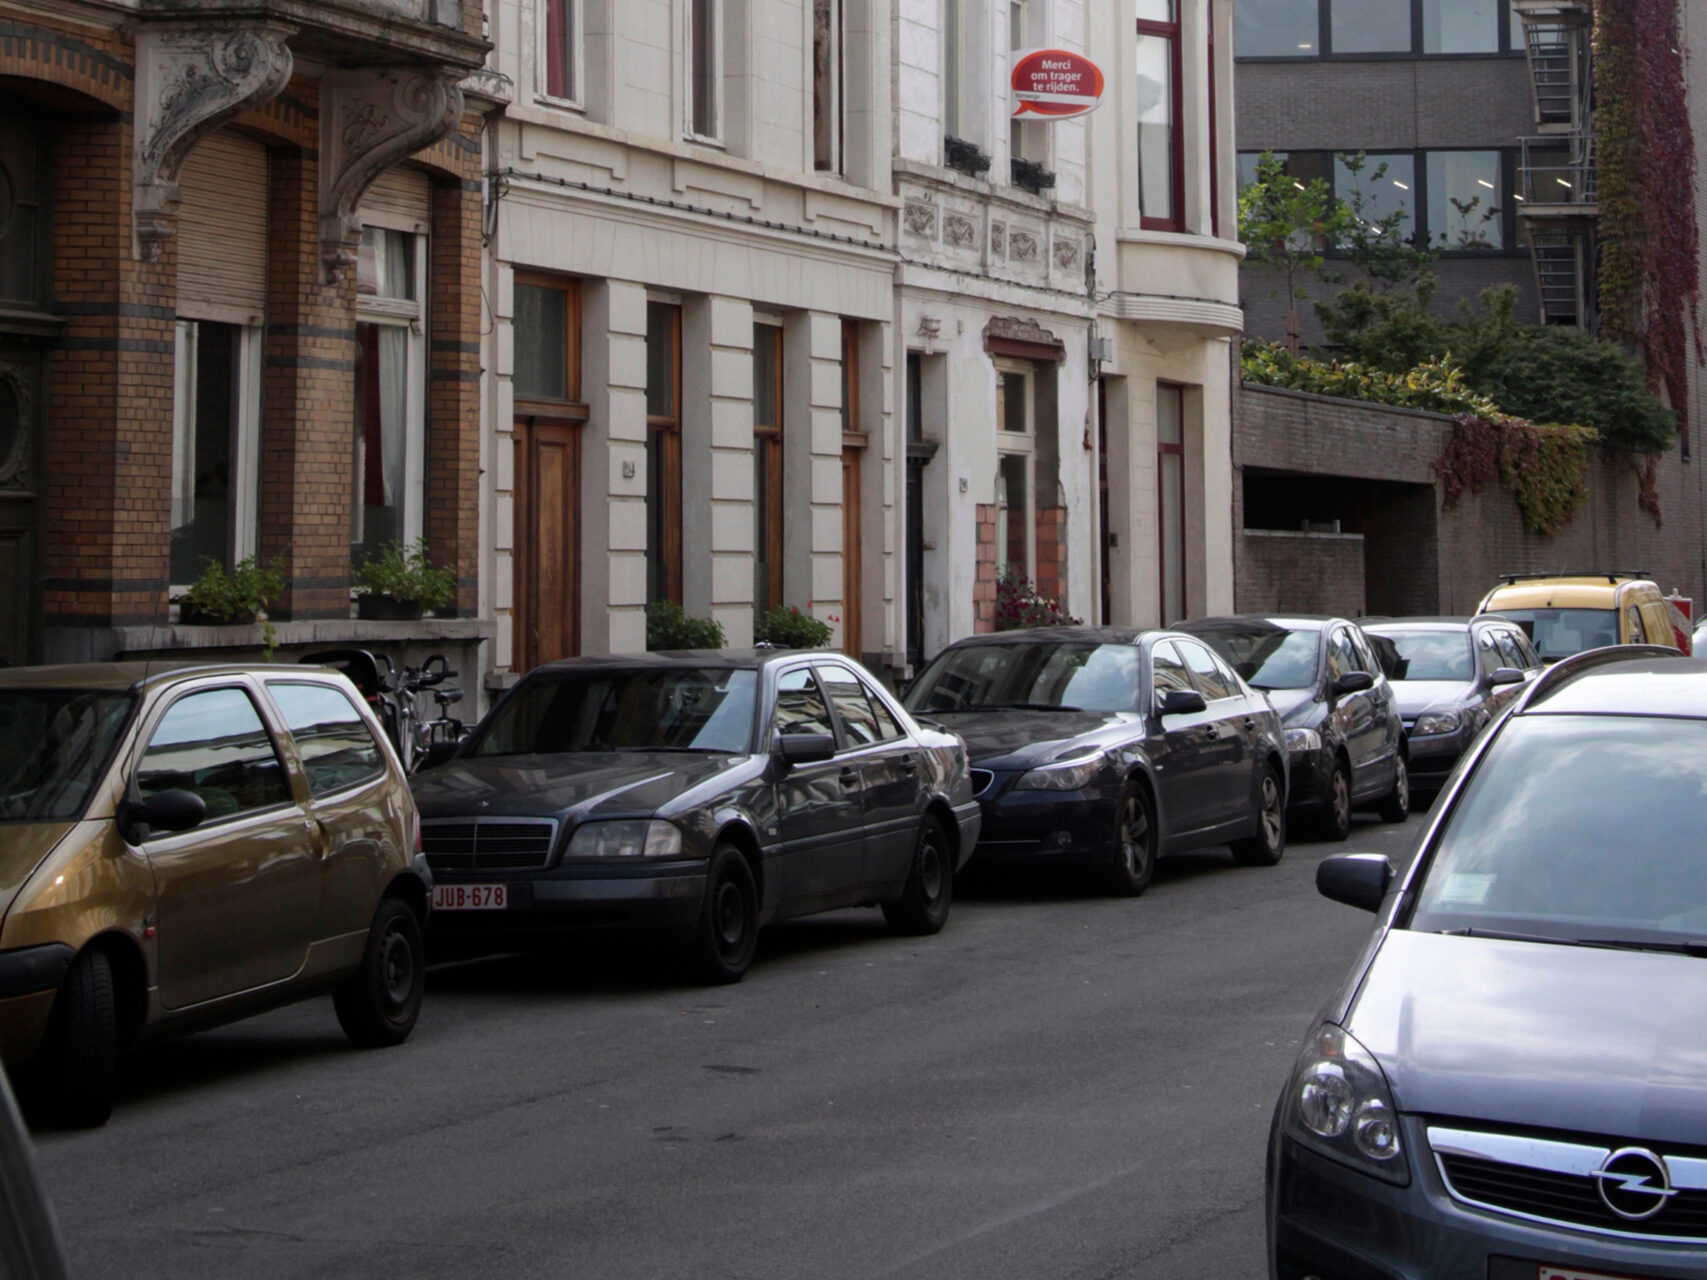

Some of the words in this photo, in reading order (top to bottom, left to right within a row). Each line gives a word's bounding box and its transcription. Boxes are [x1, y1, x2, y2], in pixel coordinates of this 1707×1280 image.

[1042, 60, 1071, 70] Merci
[1050, 71, 1082, 82] trager
[1033, 82, 1043, 91] te
[1046, 82, 1079, 92] rijden.
[435, 887, 504, 907] JUB-678
